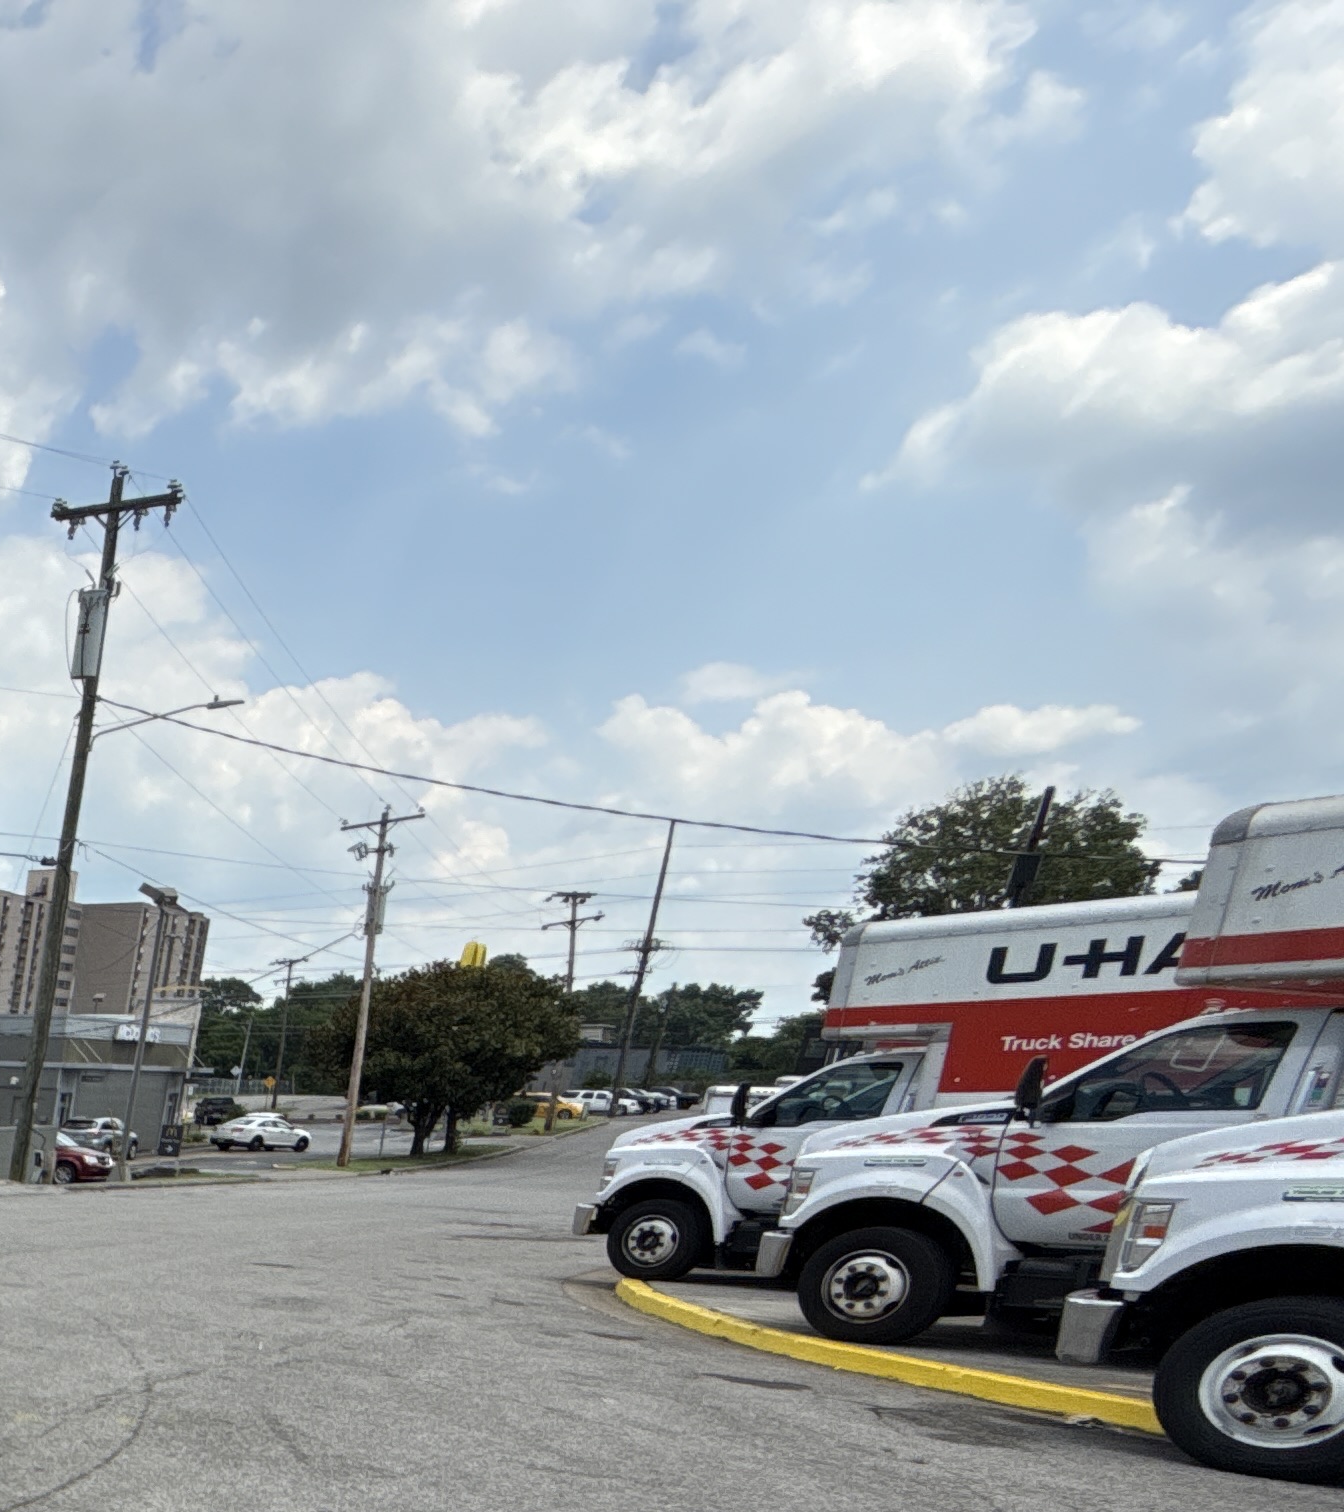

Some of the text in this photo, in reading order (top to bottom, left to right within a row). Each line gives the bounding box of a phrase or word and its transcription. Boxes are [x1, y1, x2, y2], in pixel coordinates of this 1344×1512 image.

[1250, 870, 1325, 902] Mom's
[1001, 1031, 1137, 1052] Truck Share
